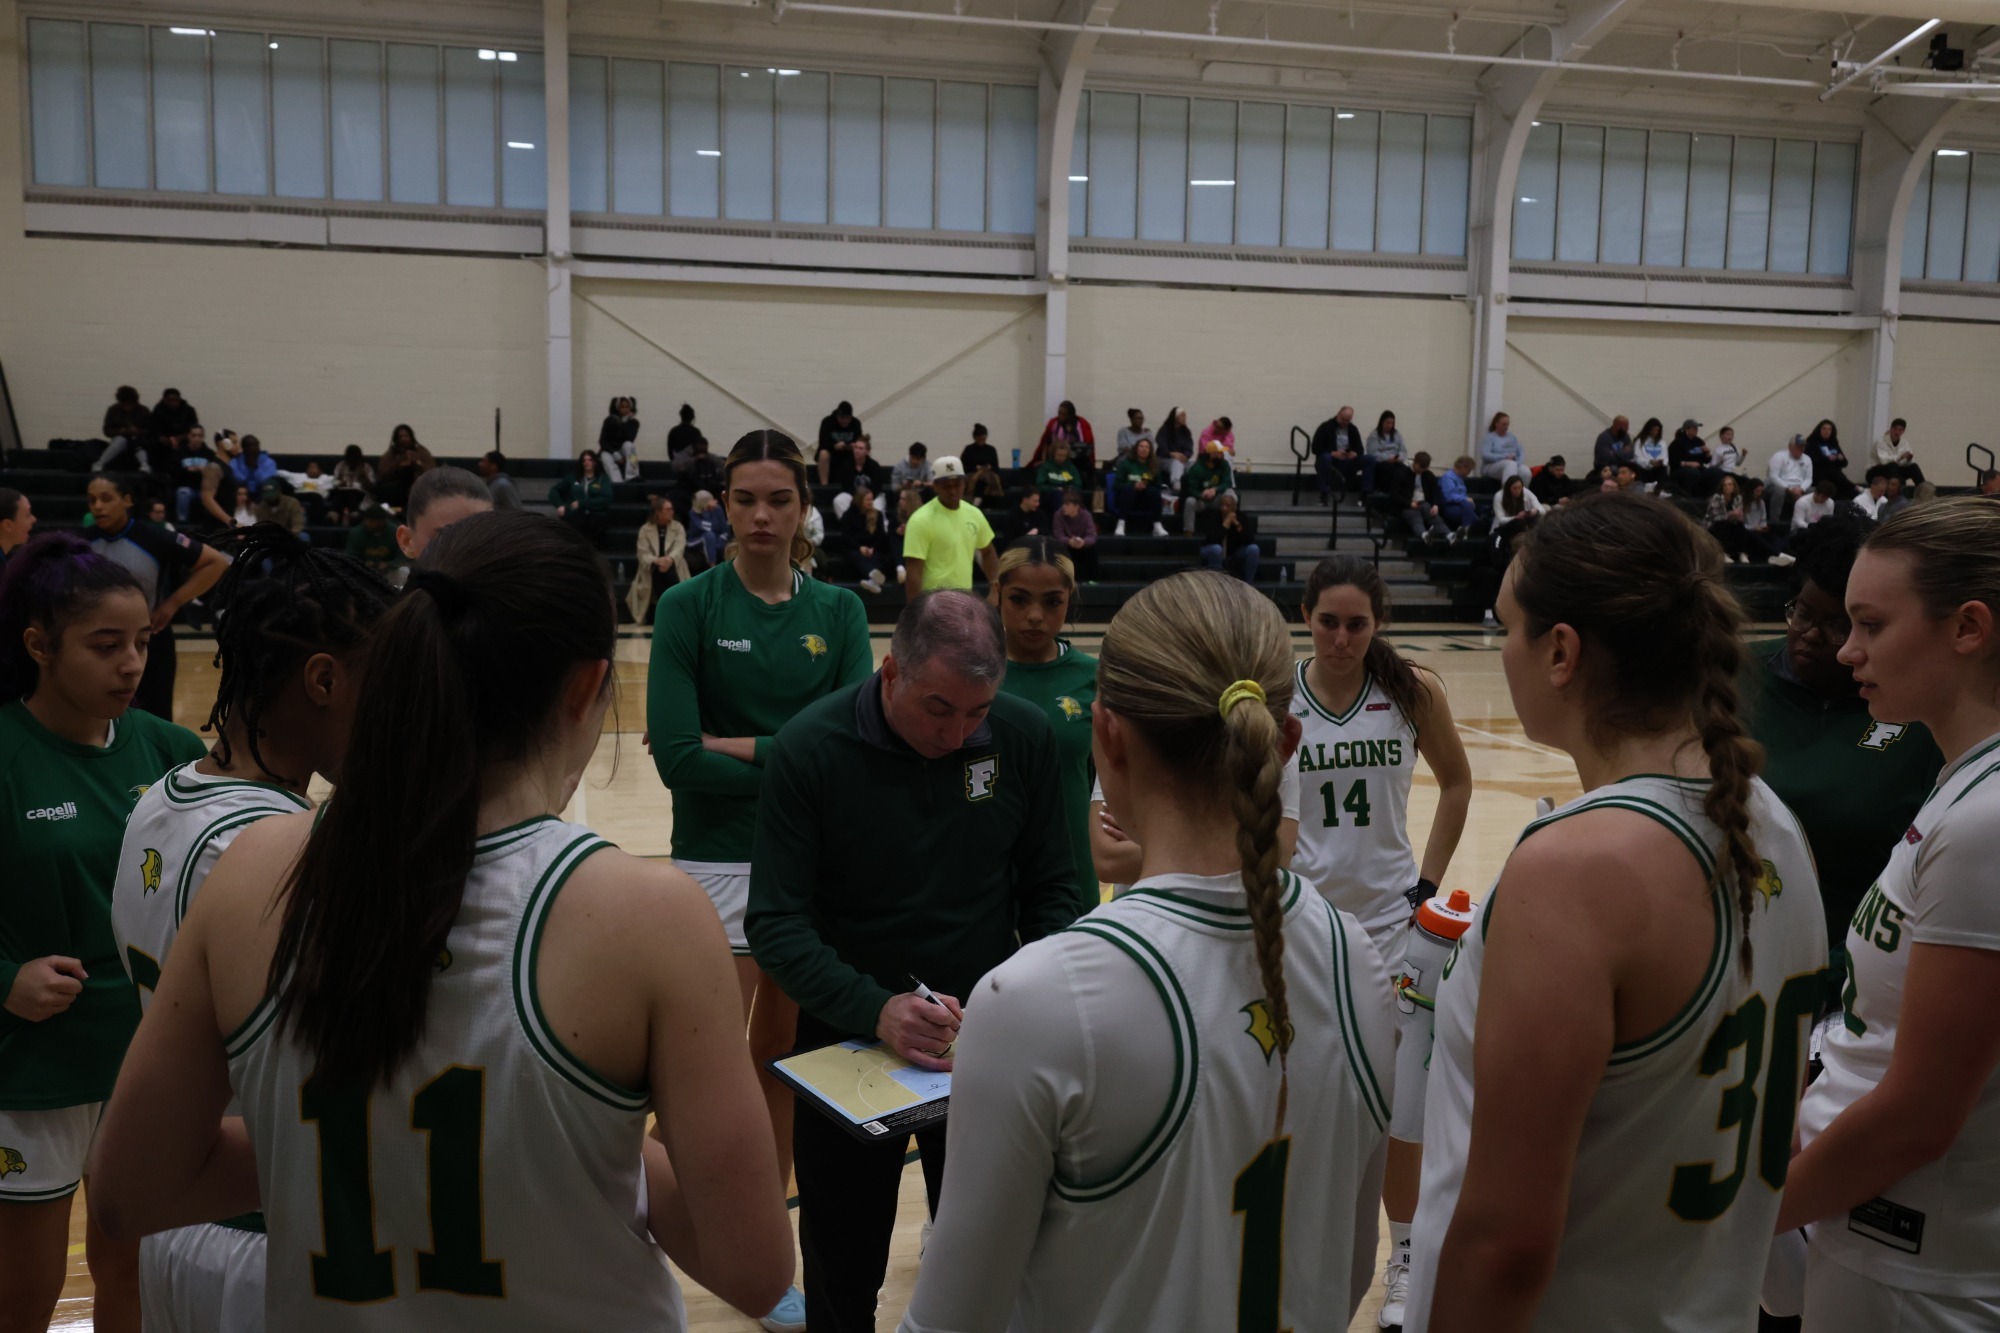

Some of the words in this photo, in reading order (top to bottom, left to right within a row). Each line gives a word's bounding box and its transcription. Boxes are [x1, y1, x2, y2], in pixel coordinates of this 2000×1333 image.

[717, 638, 752, 651] capelli
[1298, 739, 1402, 772] ALCONS
[1857, 720, 1909, 751] F
[965, 753, 1000, 802] F
[26, 801, 77, 821] capelli
[1320, 778, 1370, 827] 14
[1665, 966, 1830, 1224] 30
[301, 1064, 507, 1304] 11
[1232, 1134, 1293, 1333] 1
